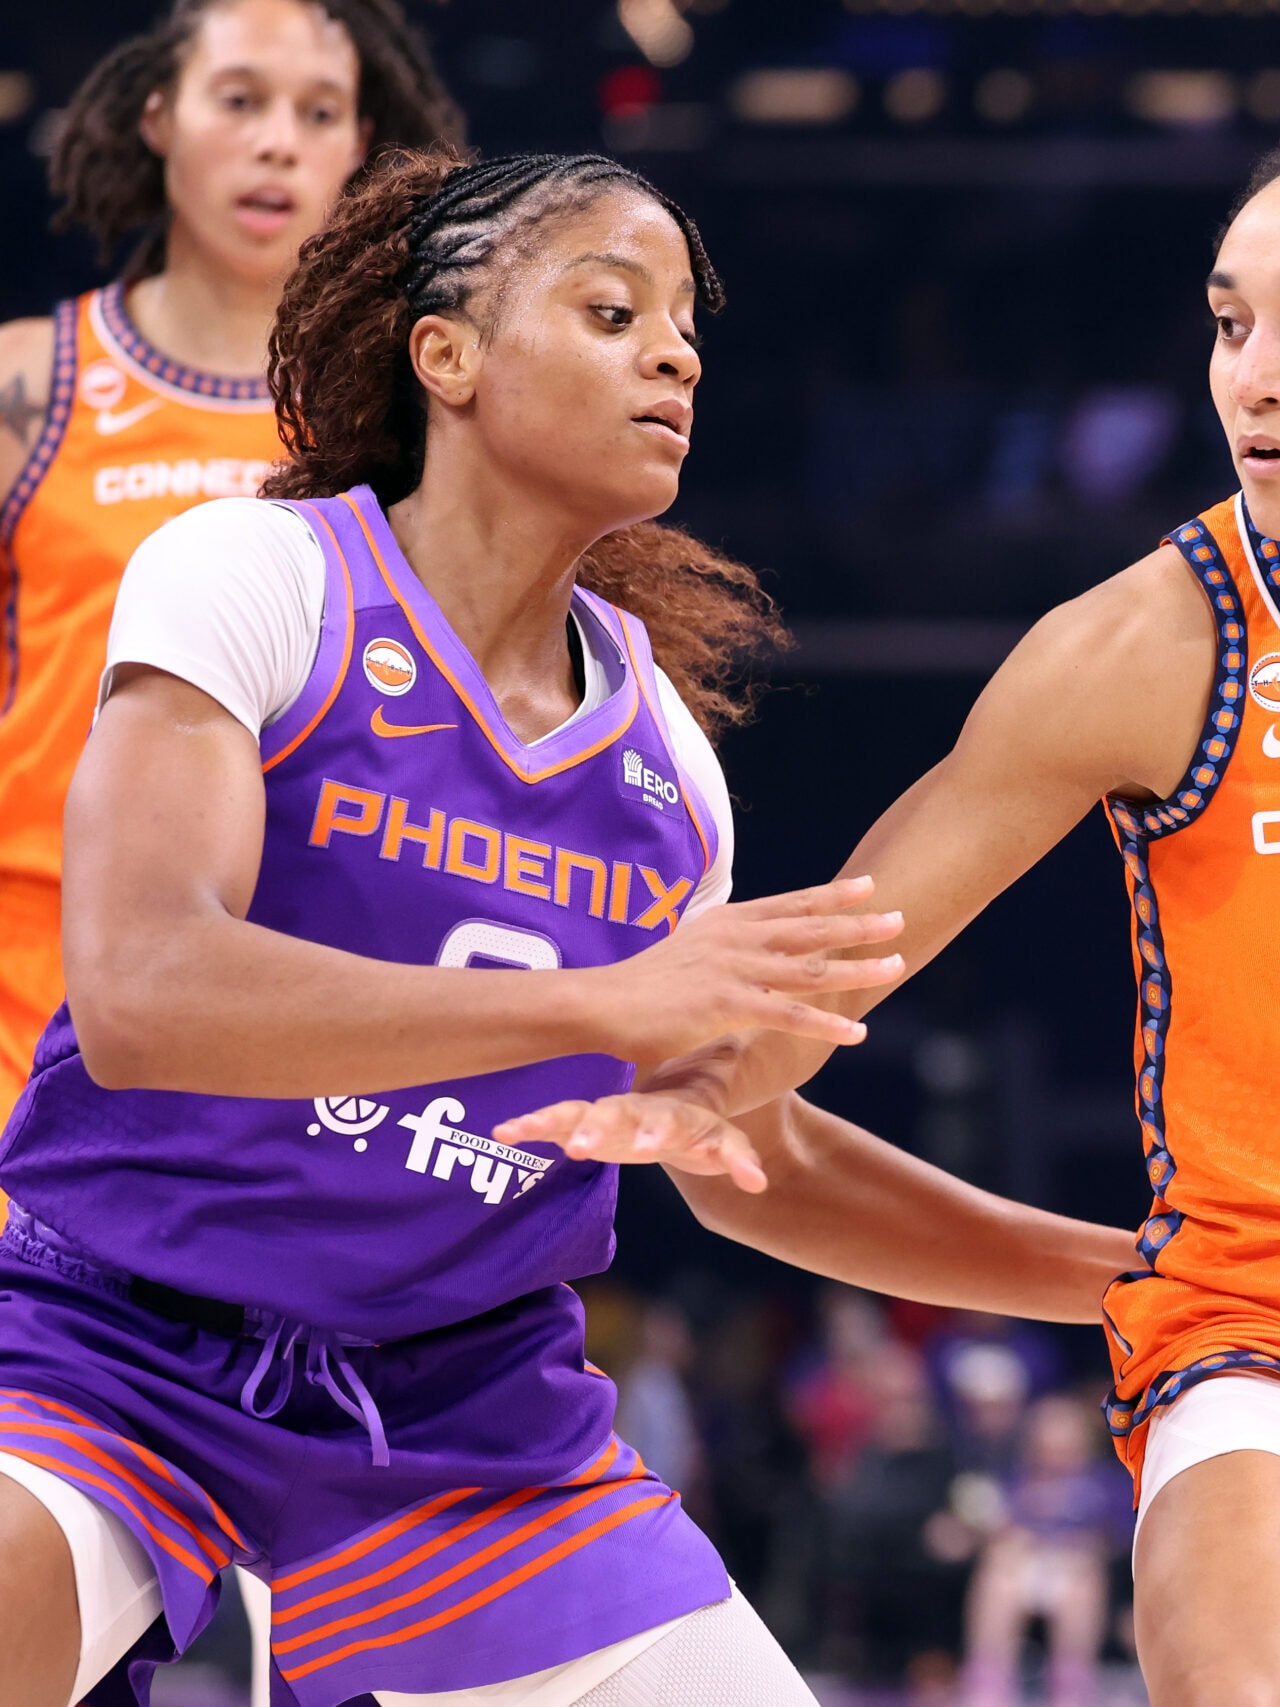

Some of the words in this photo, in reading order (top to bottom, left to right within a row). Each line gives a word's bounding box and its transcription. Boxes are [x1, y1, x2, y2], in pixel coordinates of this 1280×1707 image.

[94, 457, 276, 504] CONNEC
[623, 749, 678, 804] HERO
[307, 778, 694, 933] PHOENIX
[450, 1130, 491, 1151] FOOD
[495, 1145, 546, 1170] STORES
